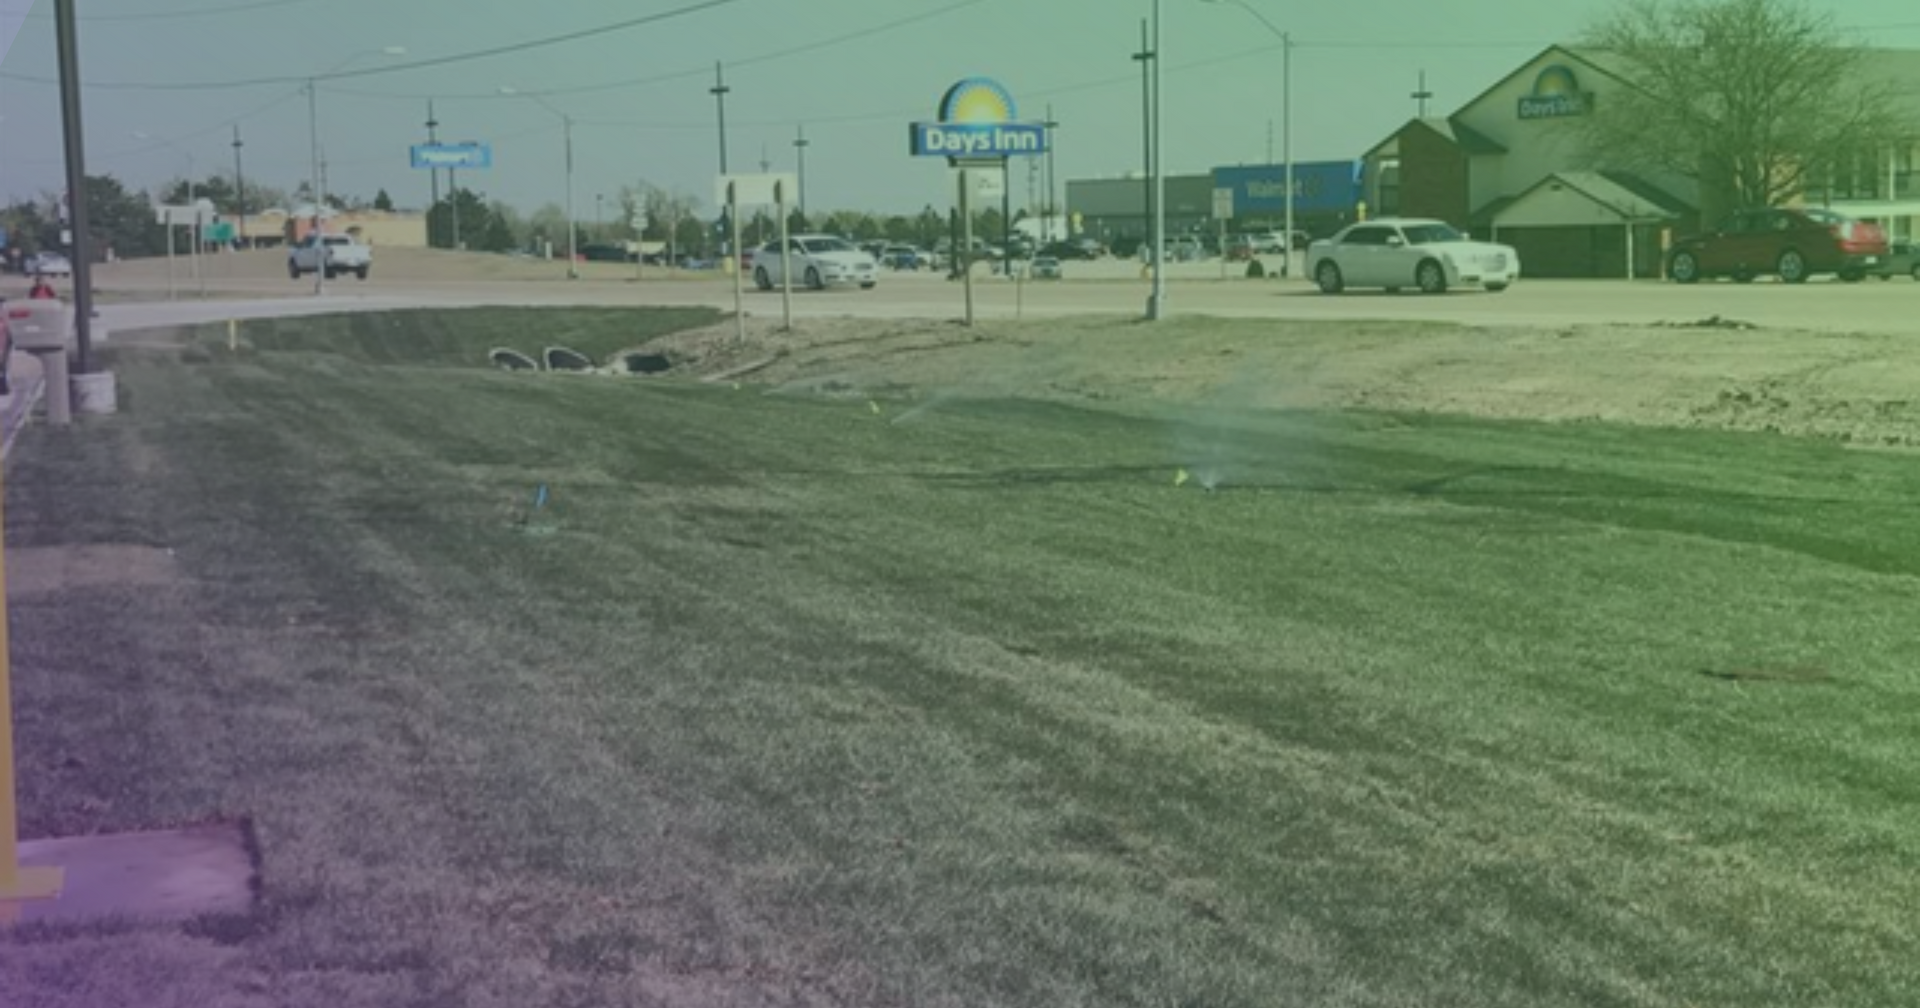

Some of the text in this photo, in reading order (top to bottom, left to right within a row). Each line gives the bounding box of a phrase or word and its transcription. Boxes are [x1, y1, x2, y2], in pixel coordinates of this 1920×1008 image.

[926, 128, 1037, 153] Days Inn
[1245, 178, 1303, 198] Walmt
